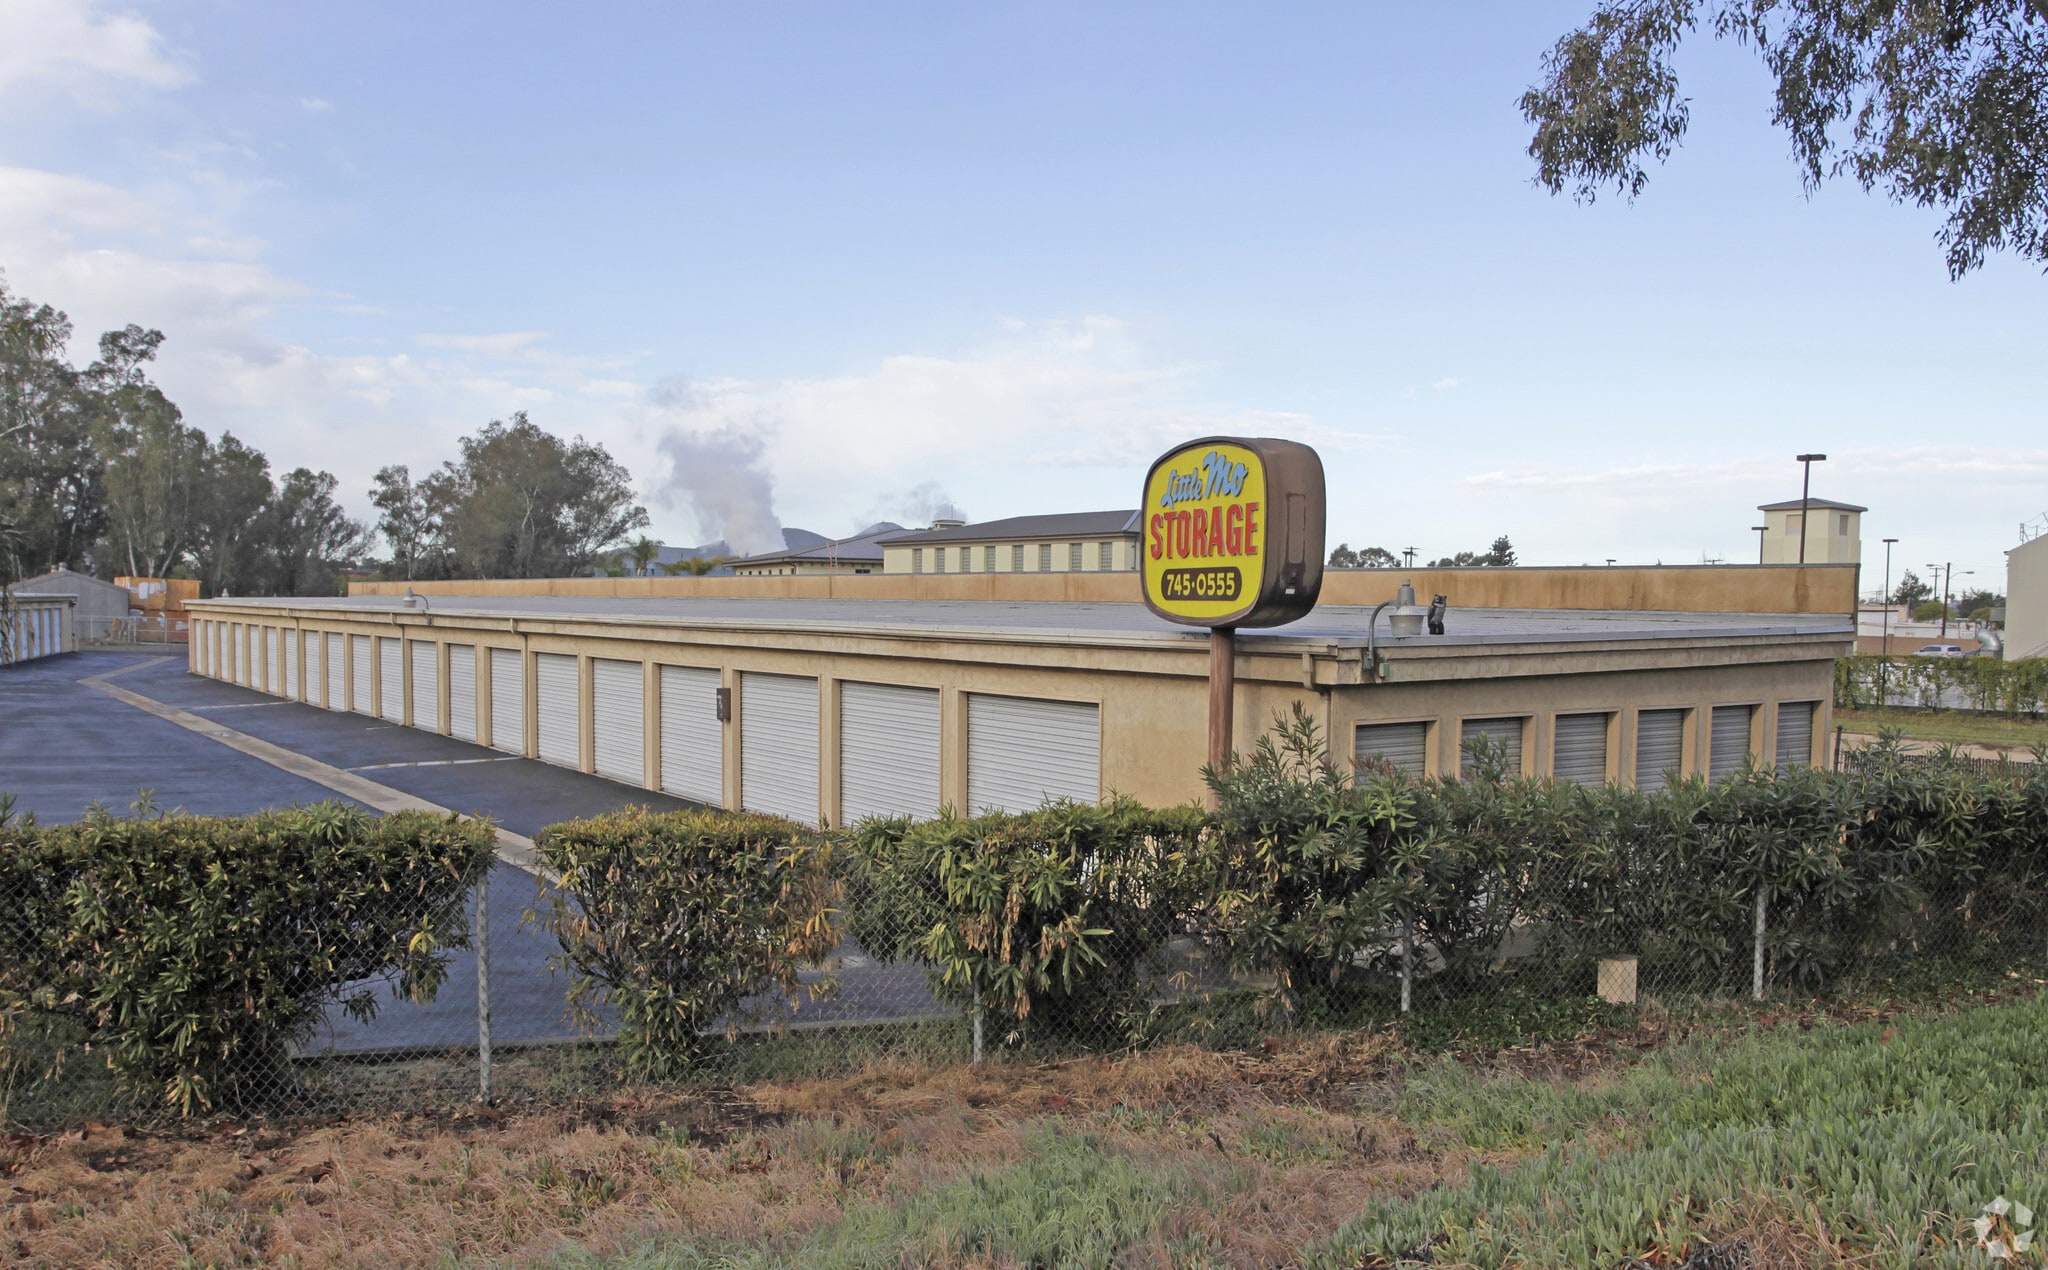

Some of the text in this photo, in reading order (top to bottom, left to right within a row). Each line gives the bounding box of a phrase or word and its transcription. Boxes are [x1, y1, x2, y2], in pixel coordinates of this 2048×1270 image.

[1161, 451, 1248, 508] Little Mo
[1150, 502, 1259, 560] STORAGE
[1166, 572, 1235, 596] 745-0555
